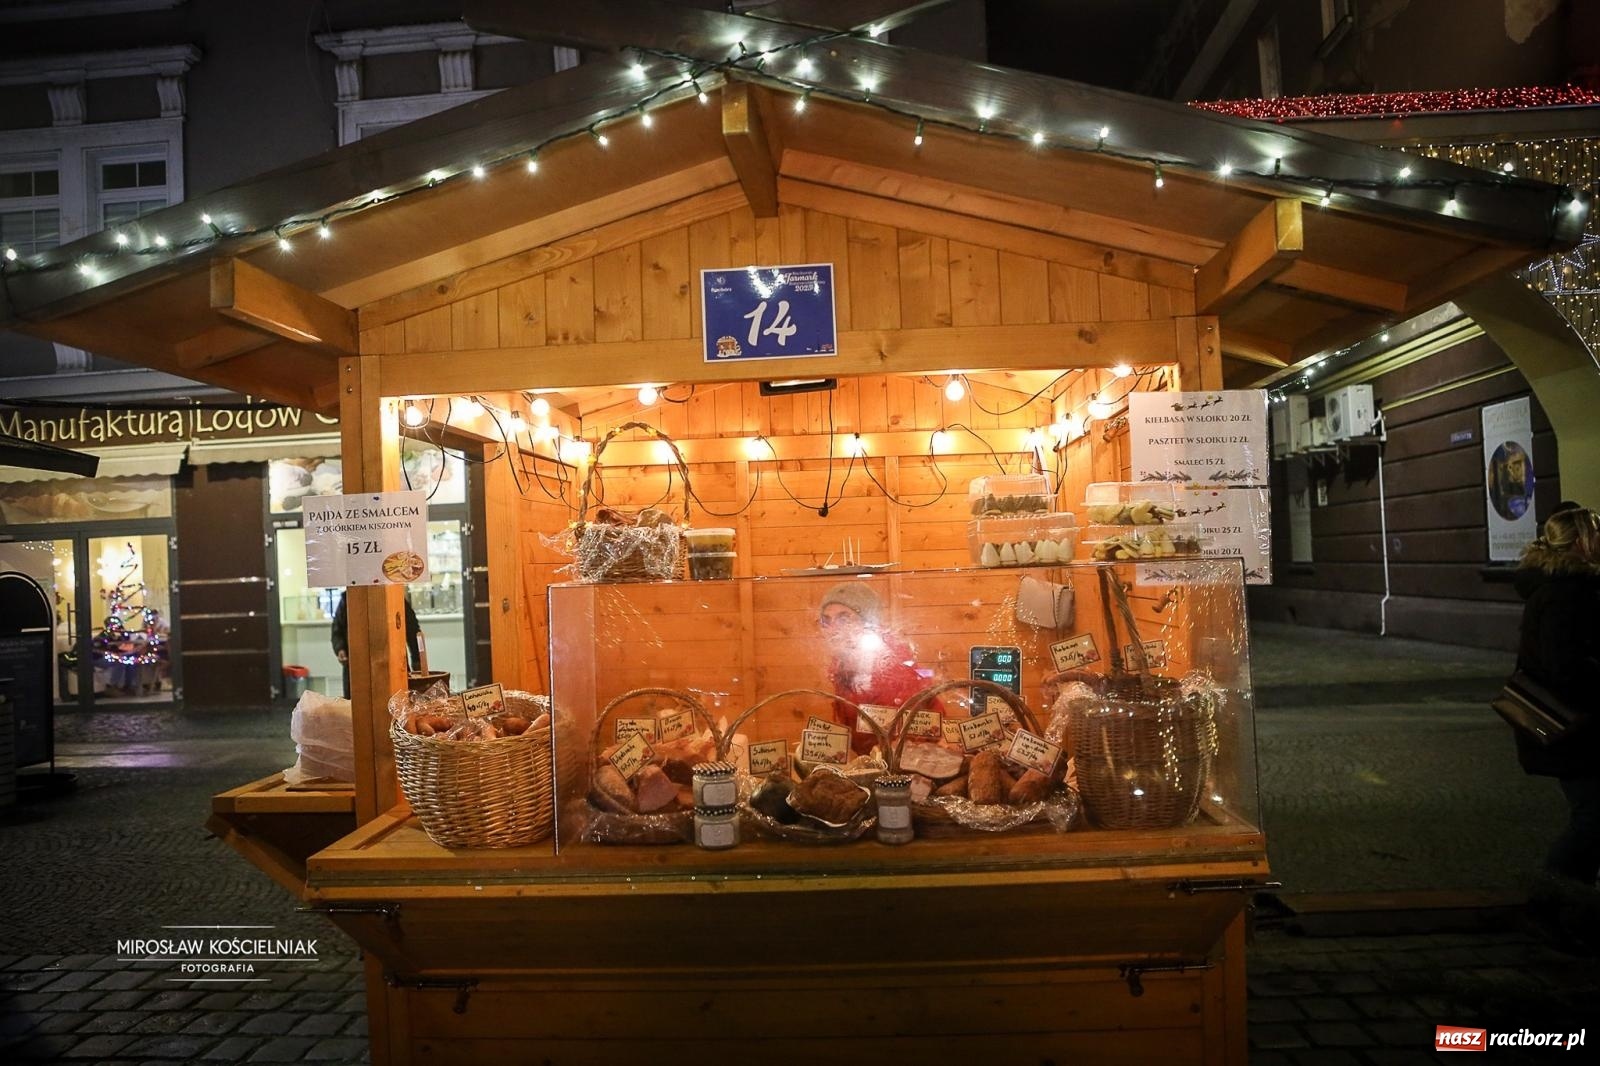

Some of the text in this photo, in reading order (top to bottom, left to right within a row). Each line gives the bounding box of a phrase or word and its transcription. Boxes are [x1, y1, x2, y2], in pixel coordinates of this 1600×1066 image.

[743, 300, 797, 346] 14
[0, 404, 183, 442] Manufaktura
[1145, 416, 1185, 424] KIEŁBASA
[1196, 415, 1228, 423] SŁOIKU
[1241, 414, 1252, 422] ZŁ
[1148, 437, 1184, 445] PASZTET
[1196, 436, 1228, 444] SŁOIKU
[309, 506, 420, 522] PAJDA ZE SMALCEM
[322, 523, 367, 533] OGÓRKIEM
[368, 521, 412, 530] KISZONYM
[1221, 526, 1231, 534] 25
[1232, 526, 1243, 534] ZŁ
[347, 541, 383, 554] 15 ZŁ
